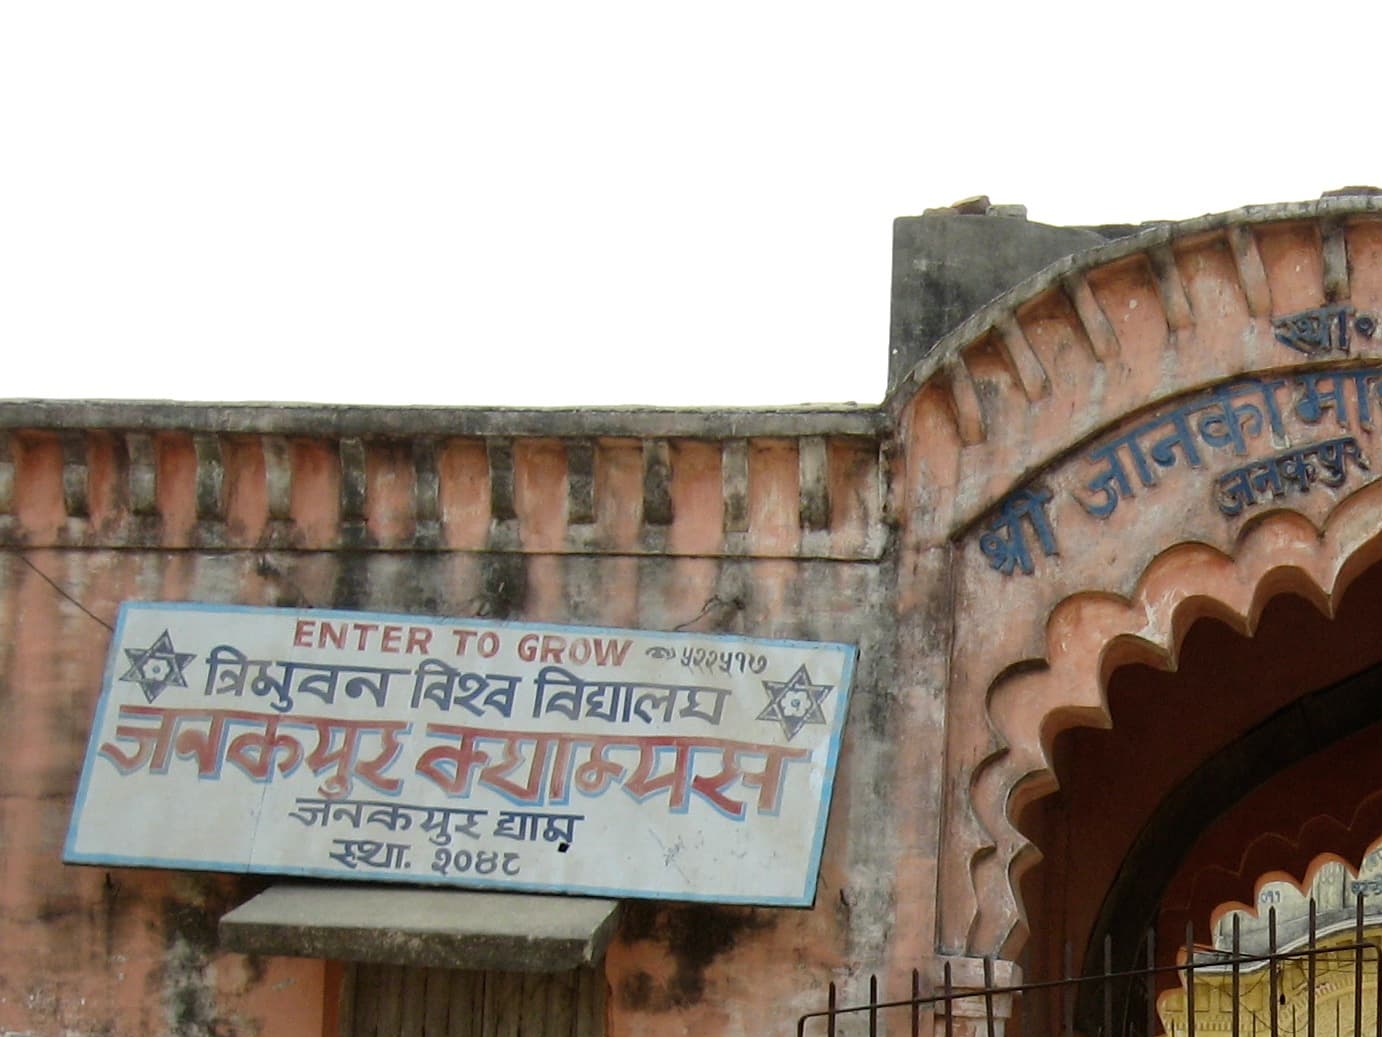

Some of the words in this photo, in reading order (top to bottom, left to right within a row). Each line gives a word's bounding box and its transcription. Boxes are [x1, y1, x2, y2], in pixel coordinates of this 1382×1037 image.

[979, 486, 1059, 577] श्री
[1084, 379, 1288, 521] जानकी
[1216, 435, 1371, 518] जनकपुर
[293, 619, 434, 655] ENTER
[452, 629, 501, 658] TO
[517, 633, 634, 668] GROW
[410, 657, 523, 719] विश्व
[531, 665, 733, 727] विद्यालय
[98, 703, 413, 799] जनकपुर
[415, 721, 812, 821] क्याम्पस
[288, 797, 489, 846] जनकपुर
